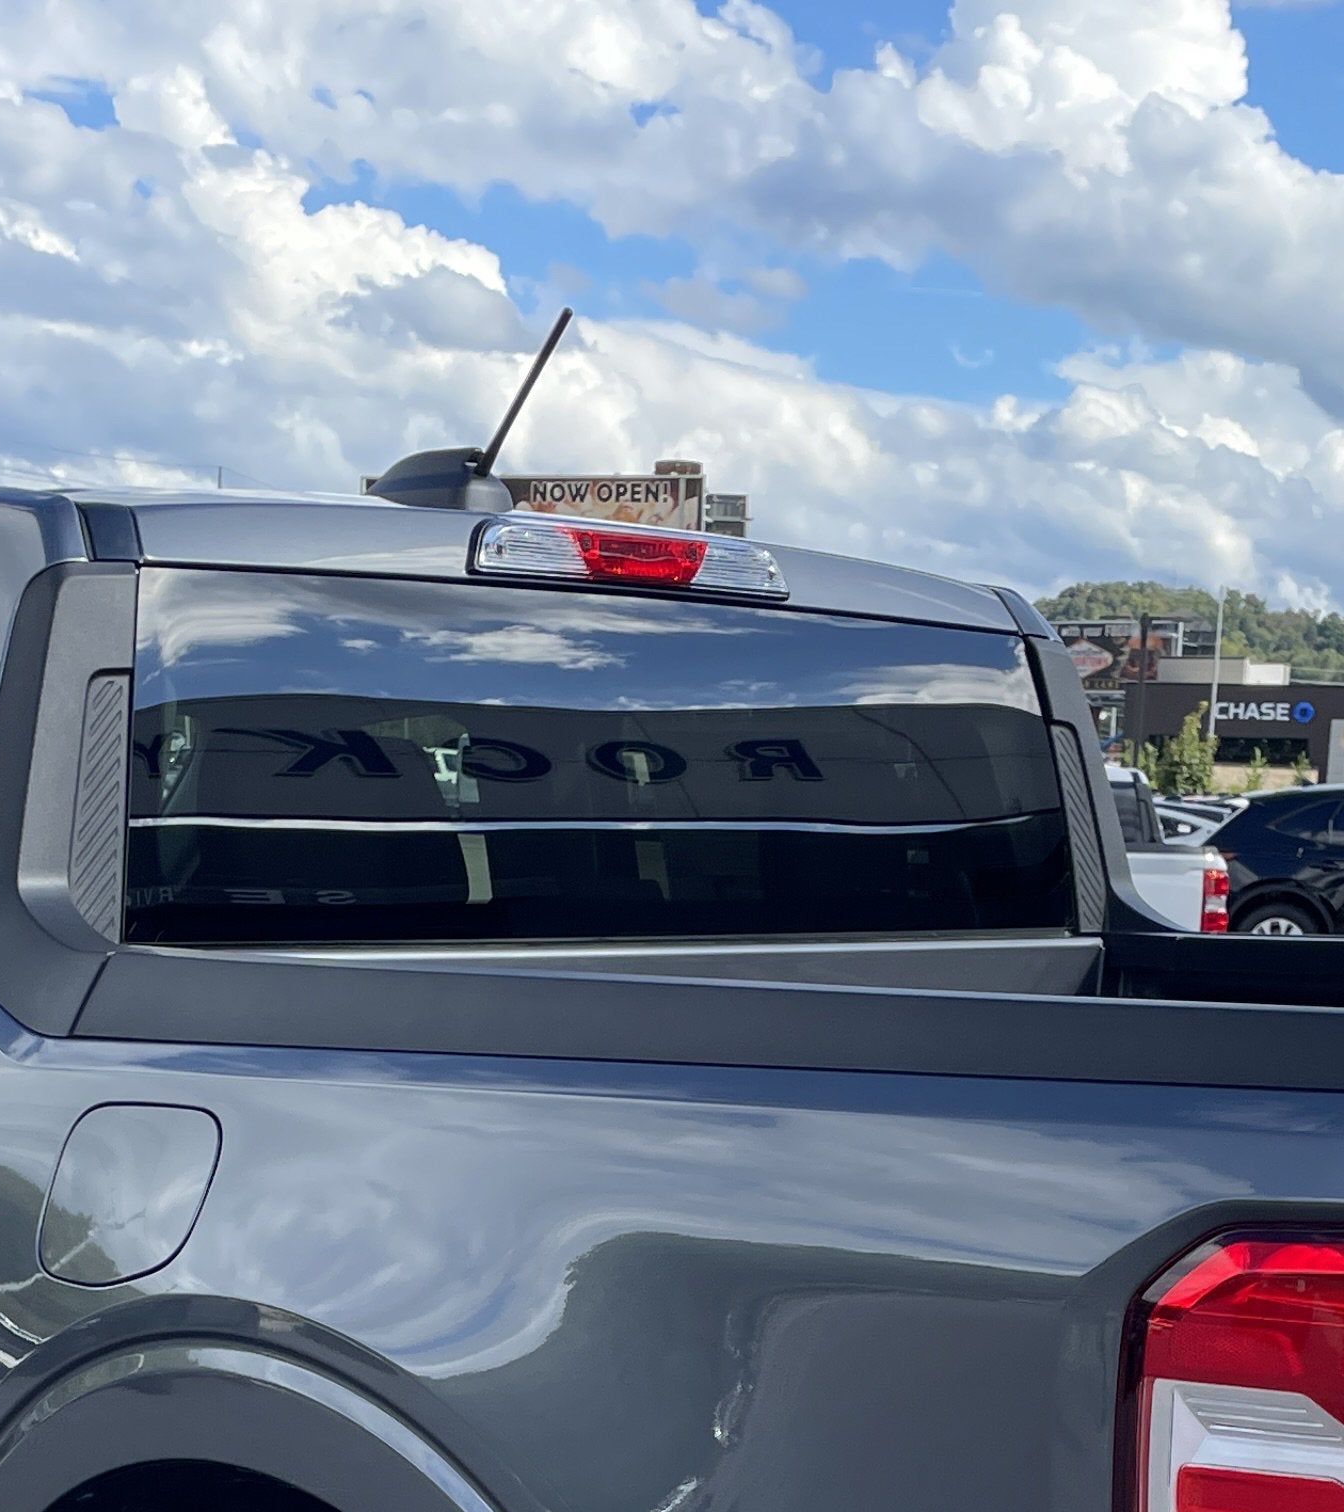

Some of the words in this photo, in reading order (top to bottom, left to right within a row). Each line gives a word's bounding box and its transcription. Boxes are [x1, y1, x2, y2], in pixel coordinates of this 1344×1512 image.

[532, 482, 590, 503] NOW
[596, 482, 669, 503] OPEN!
[1214, 702, 1290, 721] CHASE
